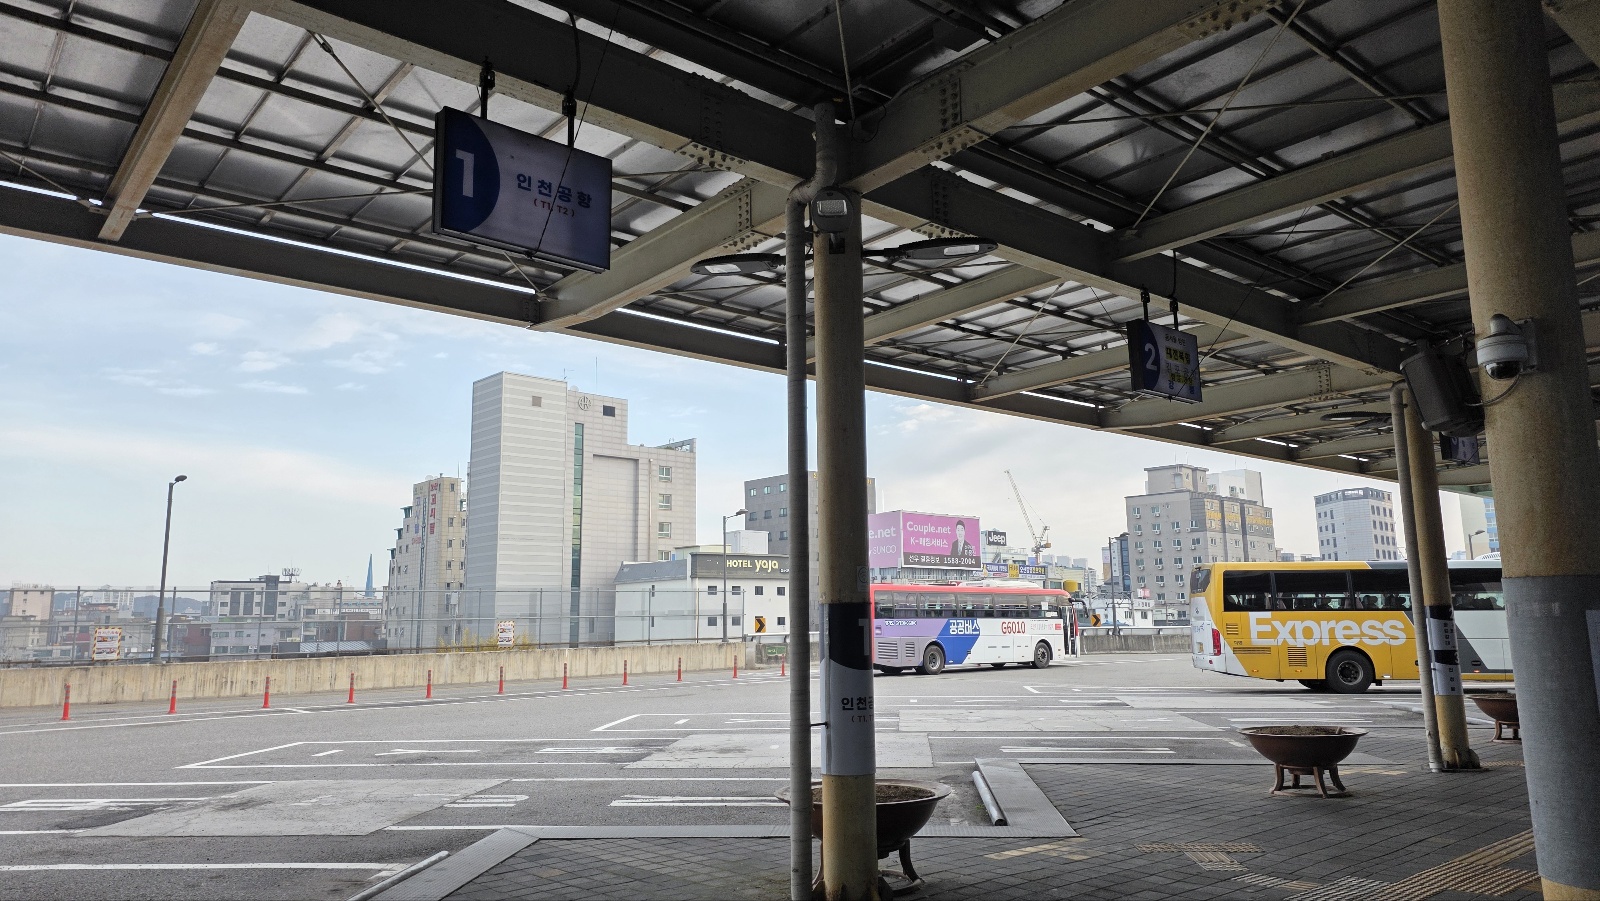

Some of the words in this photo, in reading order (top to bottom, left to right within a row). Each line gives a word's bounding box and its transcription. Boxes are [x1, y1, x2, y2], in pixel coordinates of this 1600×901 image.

[456, 148, 474, 198] 1
[516, 173, 592, 209] 인천공항
[1144, 343, 1158, 371] 2
[906, 521, 951, 534] Couple.net
[989, 532, 1006, 544] Jeep
[726, 560, 752, 568] HOTEL
[754, 560, 778, 572] yaja
[858, 618, 870, 656] 1
[949, 620, 980, 634] 공공버스
[1001, 622, 1026, 634] G6010
[1249, 612, 1407, 646] Express
